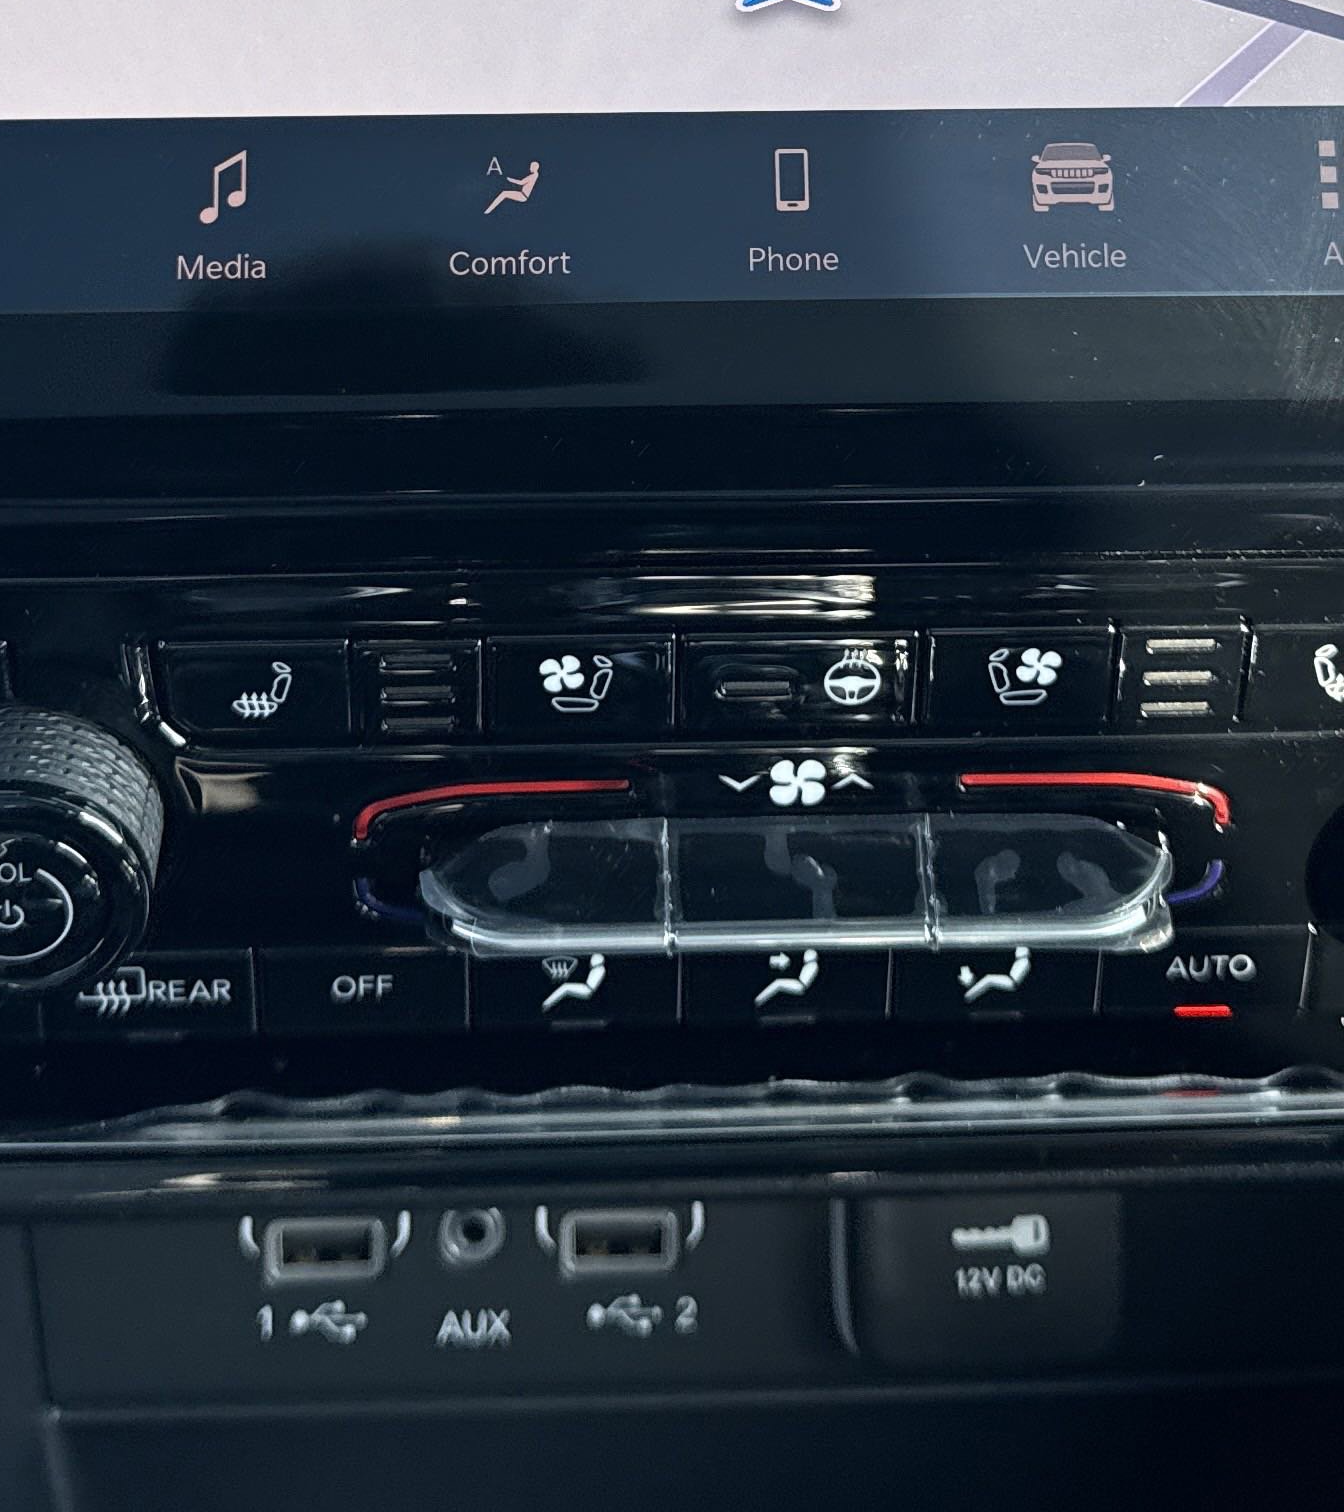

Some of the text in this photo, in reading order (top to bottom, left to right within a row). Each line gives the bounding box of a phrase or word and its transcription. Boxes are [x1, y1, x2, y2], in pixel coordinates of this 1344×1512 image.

[176, 254, 266, 279] Media
[449, 251, 569, 276] Comfort
[749, 247, 838, 272] Phone
[1023, 242, 1126, 270] Vehicle
[1167, 953, 1256, 981] AUTO
[148, 978, 232, 1004] REAR
[333, 974, 393, 1002] OFF
[954, 1263, 1046, 1295] 12V DC
[258, 1304, 273, 1341] 1
[436, 1309, 511, 1346] AUX
[675, 1296, 698, 1335] 2
